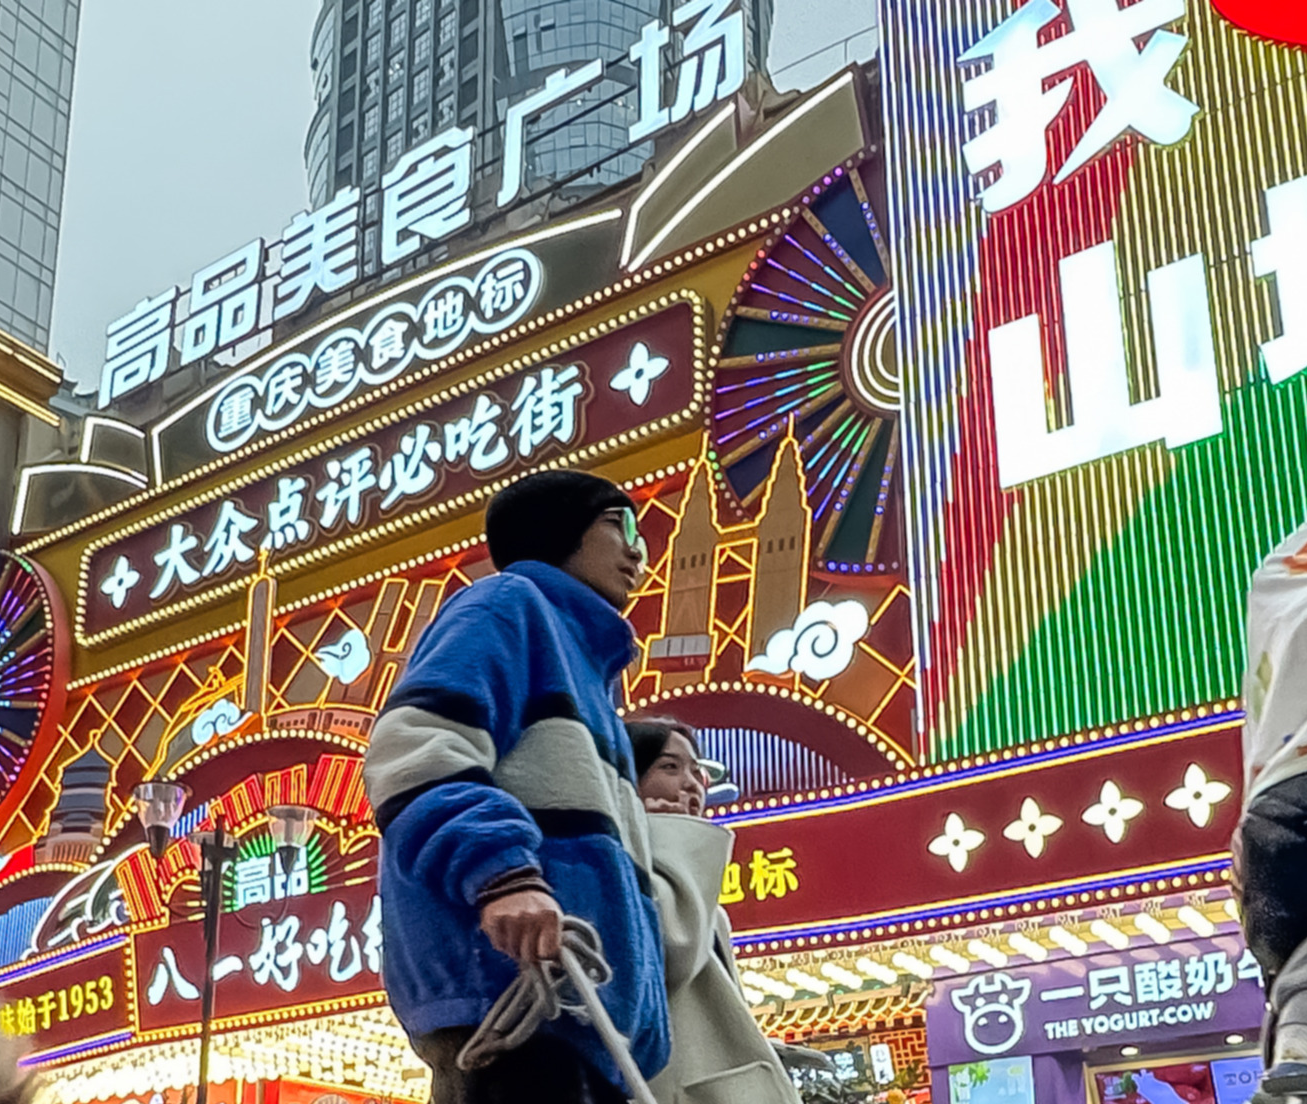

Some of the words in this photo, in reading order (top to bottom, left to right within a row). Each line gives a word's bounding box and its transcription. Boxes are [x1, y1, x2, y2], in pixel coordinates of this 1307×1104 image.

[98, 0, 745, 408] 高品美食广场
[957, 0, 1199, 213] 我
[218, 261, 525, 439] 重庆美食地标
[149, 364, 584, 599] 大众点评必吃街
[1045, 1019, 1079, 1040] THE
[1081, 1001, 1215, 1035] YOGURT-COW
